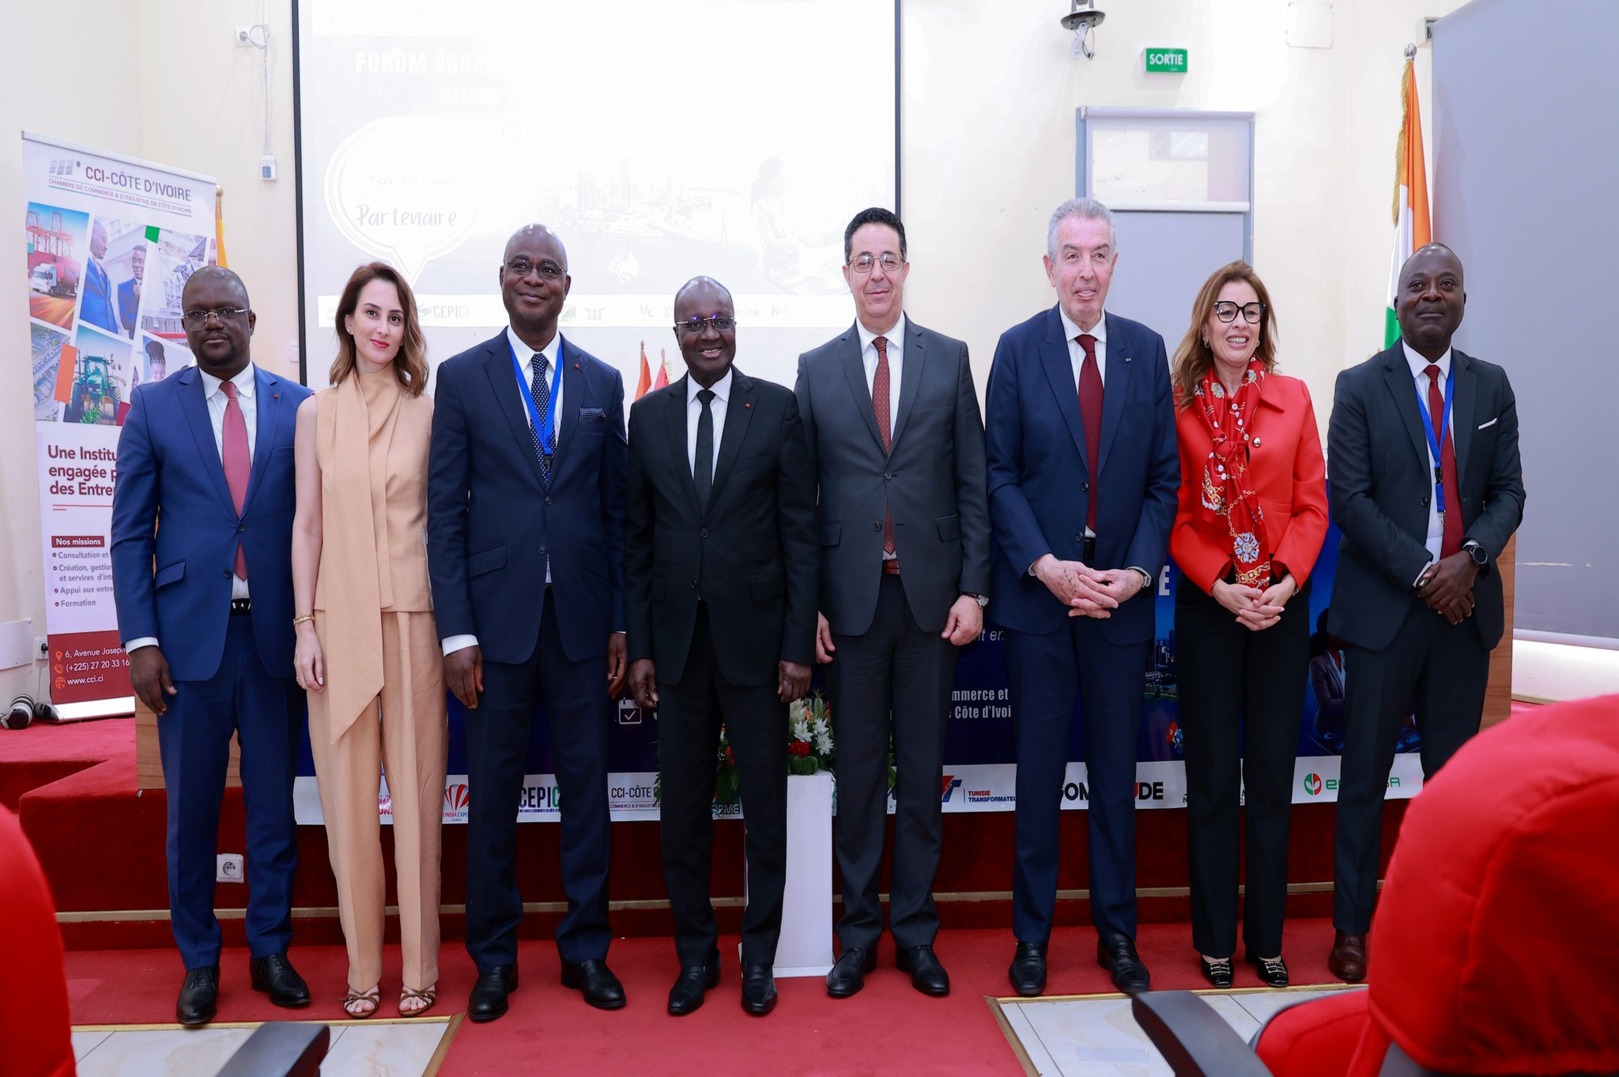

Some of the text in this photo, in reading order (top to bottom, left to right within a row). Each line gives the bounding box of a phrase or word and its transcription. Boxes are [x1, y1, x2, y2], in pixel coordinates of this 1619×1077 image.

[355, 51, 426, 74] FORUM
[1149, 53, 1184, 66] SORTIE
[86, 166, 192, 202] CCI-CÔTE D'IVOIRE
[48, 179, 75, 190] CHAMBRE
[84, 186, 114, 198] COMMERCE
[120, 194, 150, 205] D'INDUSTRIE
[158, 201, 171, 210] CÔTE
[172, 205, 192, 214] D'IVOIRE
[355, 204, 458, 227] Partenaire
[433, 304, 470, 318] CEPICI
[48, 445, 117, 461] Une Institu
[49, 464, 107, 482] engagée
[50, 480, 113, 496] des Entre
[56, 538, 101, 546] Nos missions
[58, 551, 100, 559] Consultation
[59, 564, 89, 572] Création,
[68, 574, 94, 582] services
[60, 587, 81, 595] Appui
[61, 599, 97, 608] Formation
[65, 650, 72, 659] 6,
[74, 649, 100, 658] Avenue
[66, 659, 130, 673] (+225) 27 20 33 16
[67, 674, 104, 685] www.cci.ci
[952, 688, 1009, 701] mmerce et
[955, 705, 979, 719] Côte
[611, 784, 652, 799] CCI-CÔTE
